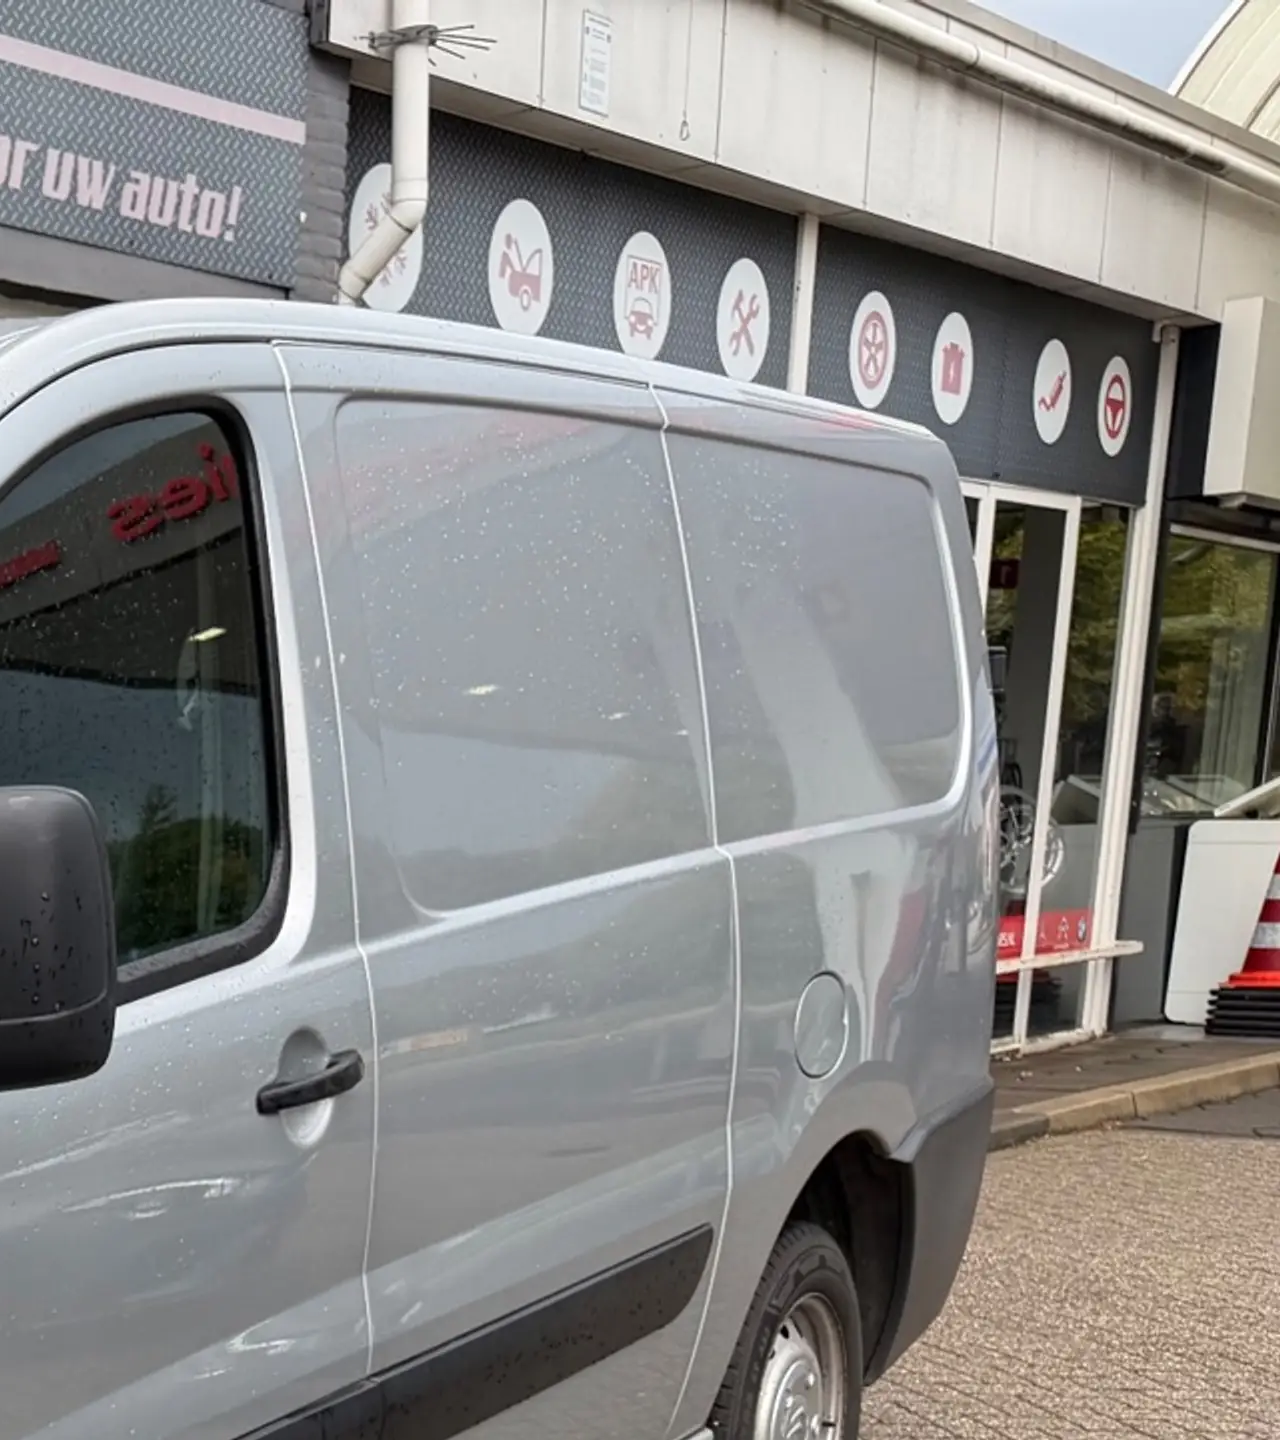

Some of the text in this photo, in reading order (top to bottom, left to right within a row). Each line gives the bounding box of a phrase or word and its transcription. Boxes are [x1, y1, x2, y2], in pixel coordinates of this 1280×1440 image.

[42, 148, 116, 211] uw
[120, 170, 242, 242] auto!
[627, 261, 661, 295] APK
